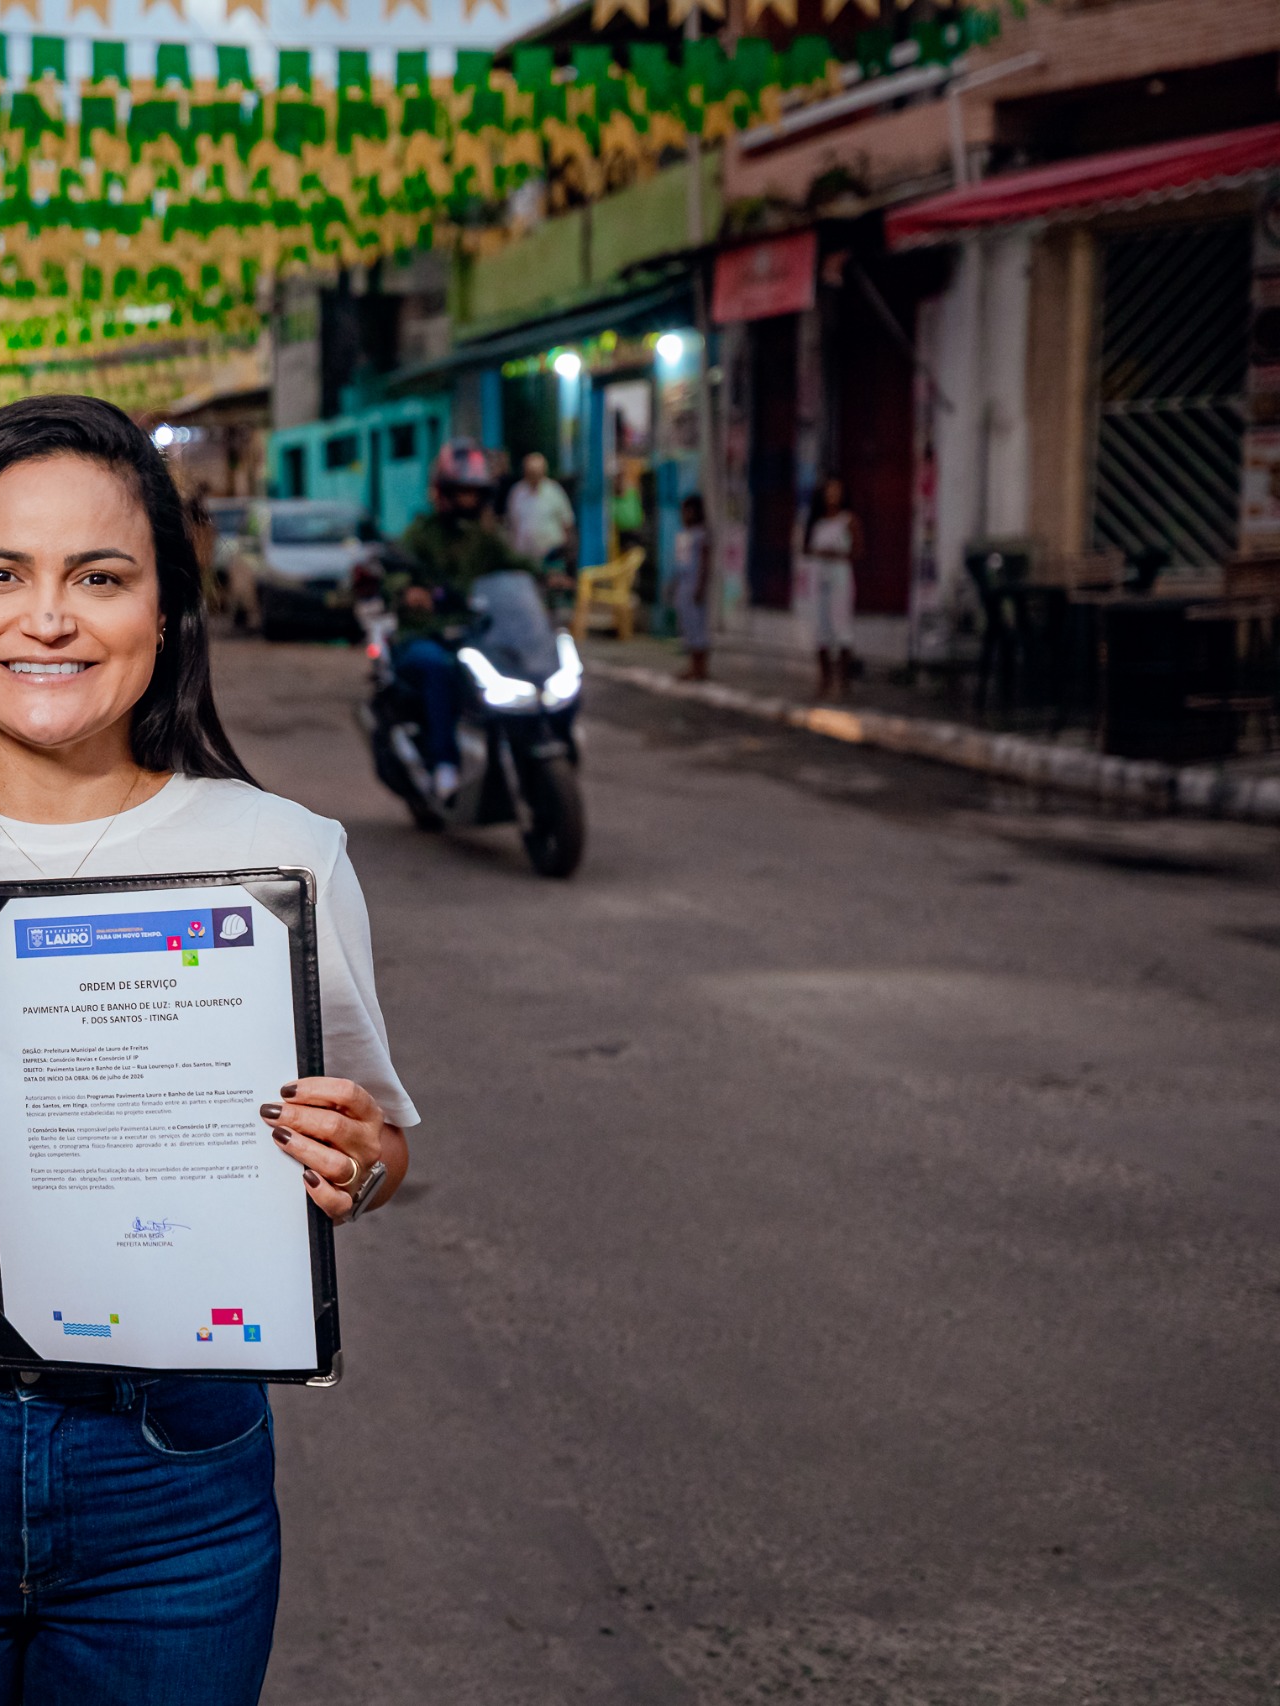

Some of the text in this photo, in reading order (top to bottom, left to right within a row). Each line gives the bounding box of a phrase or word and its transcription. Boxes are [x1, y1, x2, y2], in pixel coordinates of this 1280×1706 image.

[45, 932, 89, 945] LAURO
[80, 979, 177, 992] ORDEM DE SERVIÇO
[23, 1006, 70, 1014] PAVIMENTA
[72, 1004, 98, 1012] LAURO
[107, 1003, 137, 1011] BANHO
[196, 998, 242, 1007] LOURENÇO
[110, 1015, 142, 1023] SANTOS
